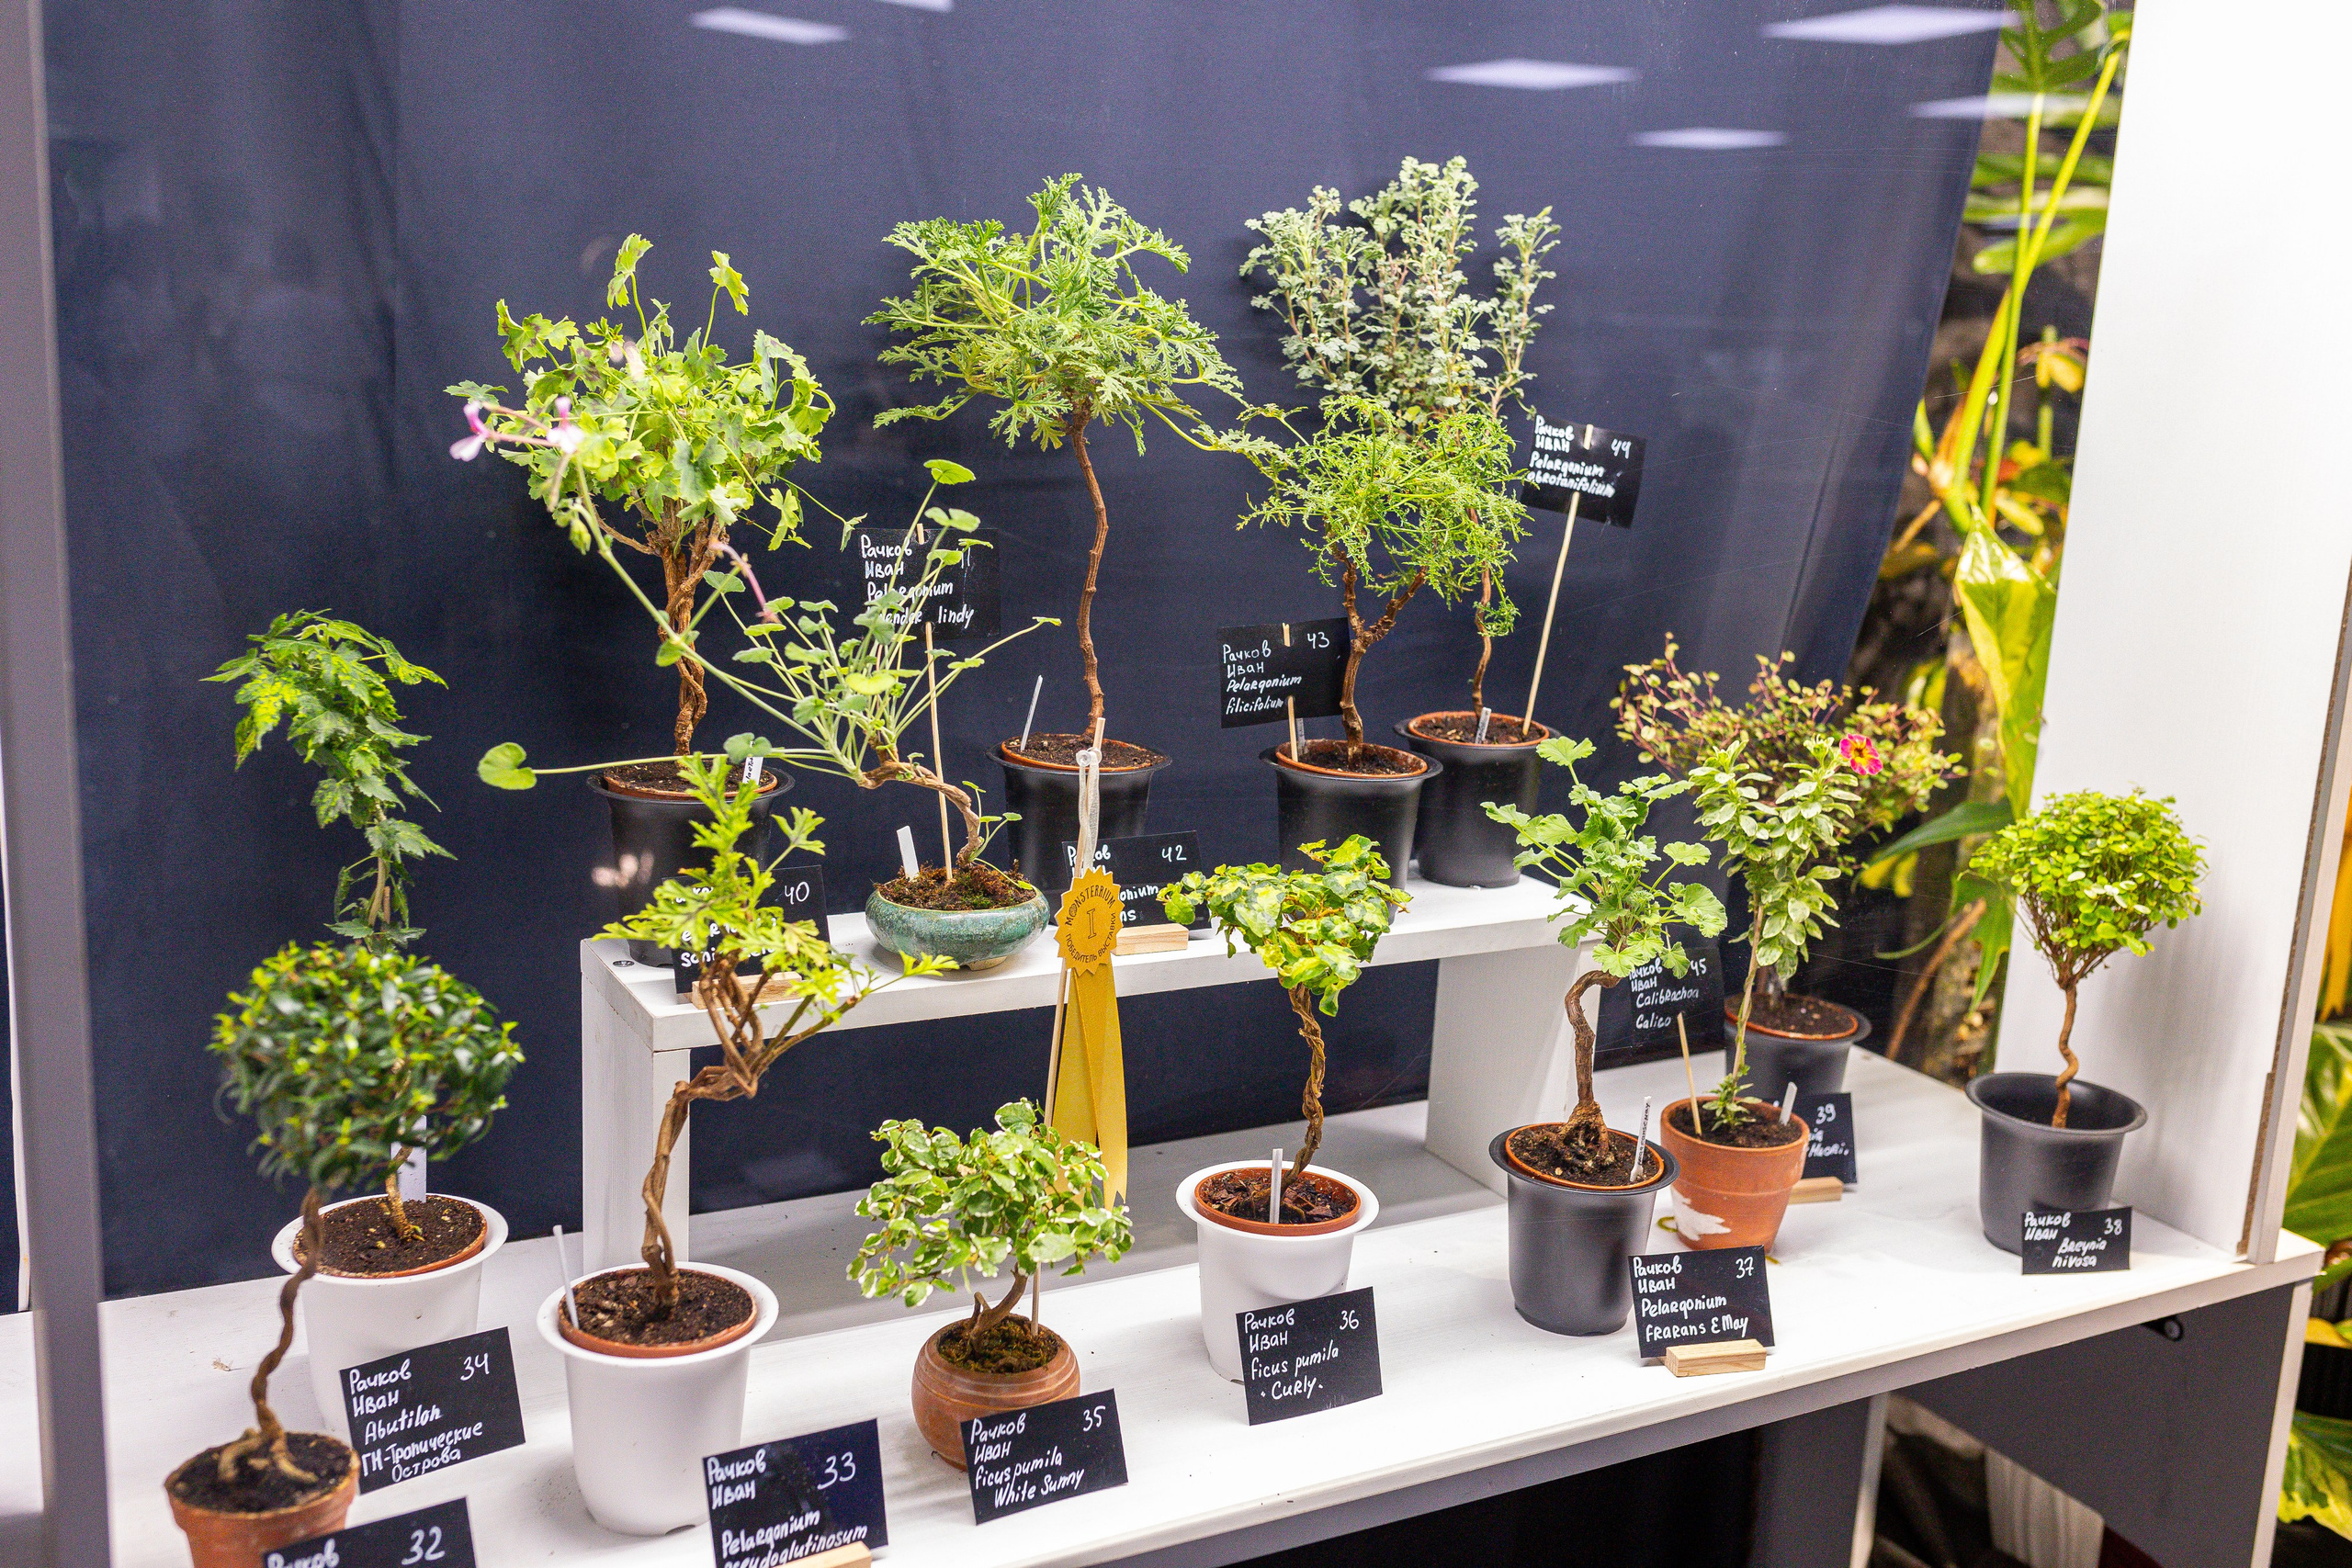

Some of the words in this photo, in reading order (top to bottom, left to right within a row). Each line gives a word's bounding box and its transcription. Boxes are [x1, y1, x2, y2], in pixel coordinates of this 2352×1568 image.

[1611, 438, 1632, 459] 44
[938, 604, 975, 629] lindy
[1223, 639, 1272, 663] Рачков
[1306, 631, 1330, 649] 43
[1227, 661, 1264, 679] Иван
[1226, 695, 1284, 715] filicifolium
[1161, 844, 1187, 862] 42
[784, 881, 809, 905] 40
[1066, 933, 1097, 964] ПОБЕДИТЕЛЬ
[1097, 912, 1116, 956] ВЫСТАВКИ
[1690, 958, 1706, 976] 45
[1631, 976, 1657, 992] Иван
[1635, 1012, 1671, 1029] Calico
[1815, 1102, 1836, 1124] 39
[2024, 1211, 2071, 1228] Рачков
[2104, 1217, 2123, 1235] 38
[1633, 1255, 1682, 1278] Рачков
[1736, 1257, 1754, 1279] 37
[2052, 1255, 2097, 1268] nivosa
[1638, 1277, 1676, 1293] Иван
[1244, 1308, 1295, 1333] Рачков
[1339, 1310, 1360, 1330] 36
[1250, 1330, 1288, 1353] Иван
[460, 1352, 490, 1381] 34
[1251, 1357, 1288, 1380] ficus
[1295, 1339, 1339, 1377] pumila
[349, 1359, 413, 1394] Рачков
[352, 1389, 399, 1417] Иван
[365, 1404, 442, 1445] Abutilon
[970, 1412, 1027, 1445] Рачков
[1082, 1405, 1106, 1432] 35
[391, 1446, 461, 1483] Острова
[707, 1449, 766, 1485] Рачков
[817, 1451, 856, 1489] 33
[1011, 1446, 1063, 1488] pumila
[712, 1480, 755, 1509] Иван
[994, 1480, 1036, 1508] White
[401, 1526, 446, 1565] 32
